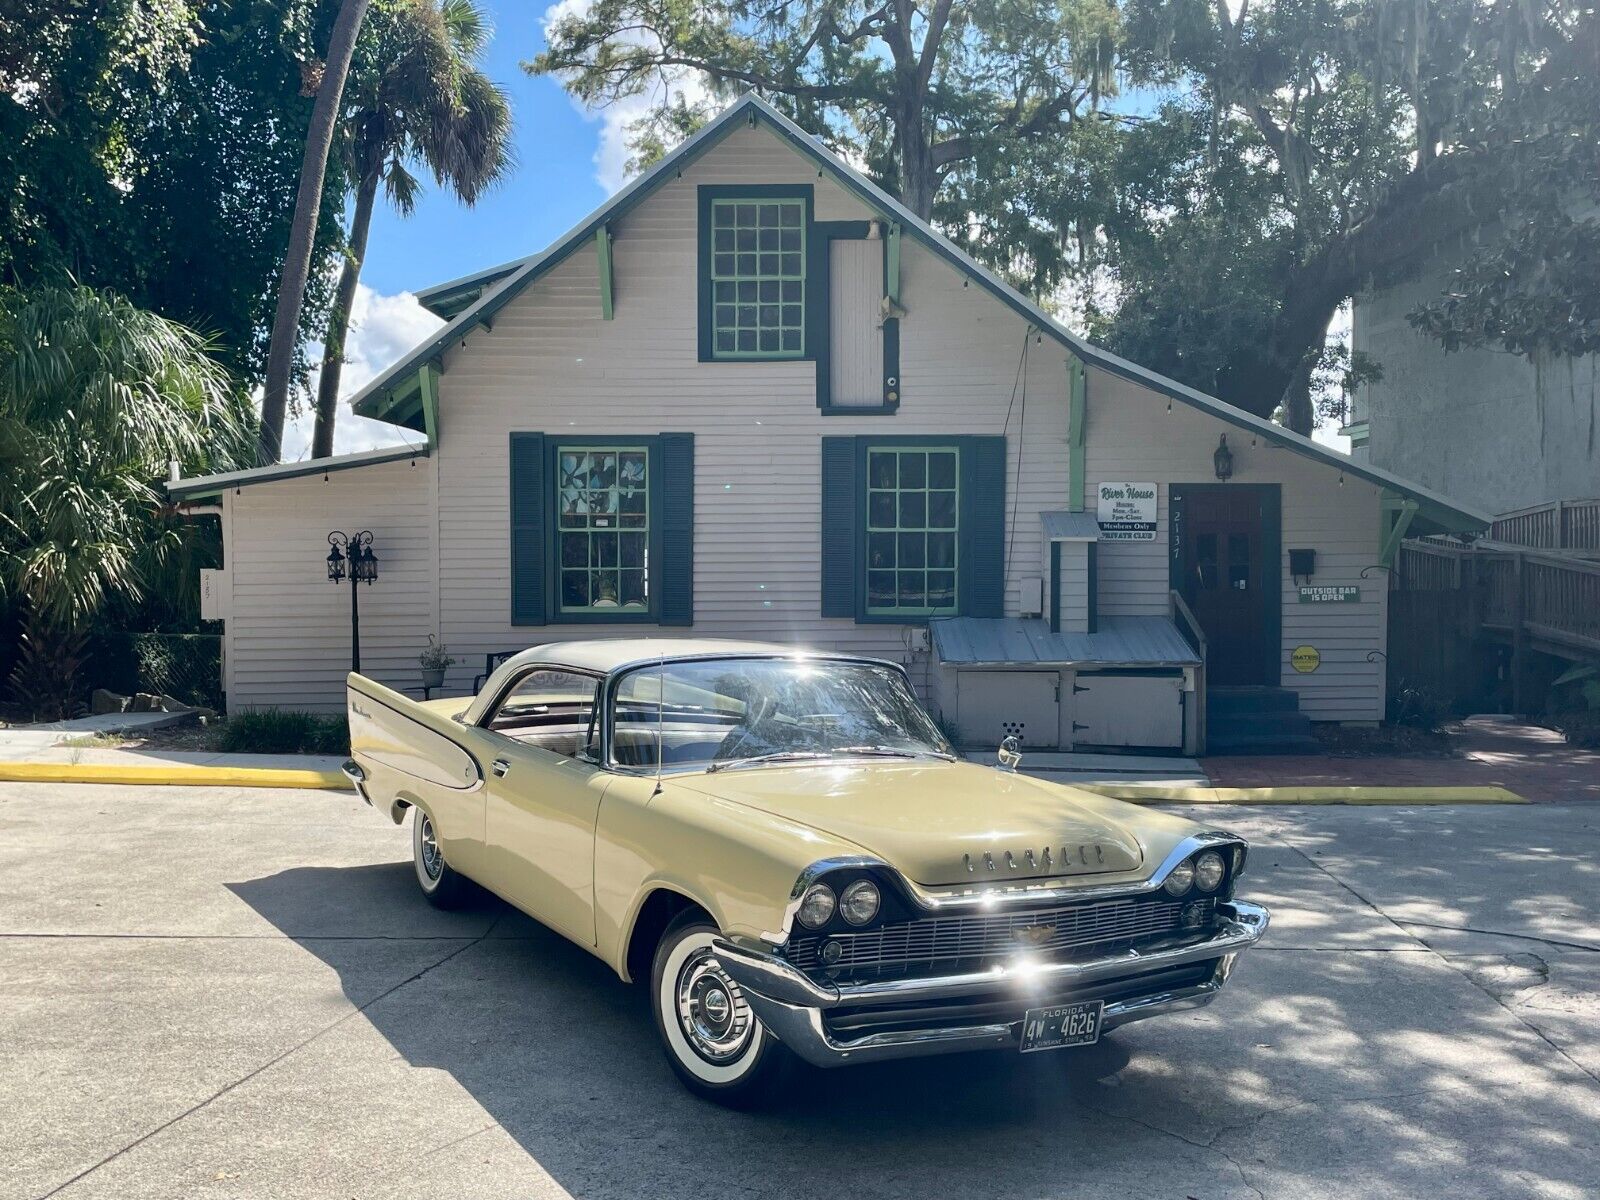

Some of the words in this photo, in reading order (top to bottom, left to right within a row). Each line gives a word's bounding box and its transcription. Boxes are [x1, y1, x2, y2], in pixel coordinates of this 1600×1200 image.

[1101, 487, 1124, 500] River
[1126, 487, 1154, 499] House
[1301, 587, 1337, 595] OUTSIDE
[1043, 1006, 1084, 1018] FLORIDA
